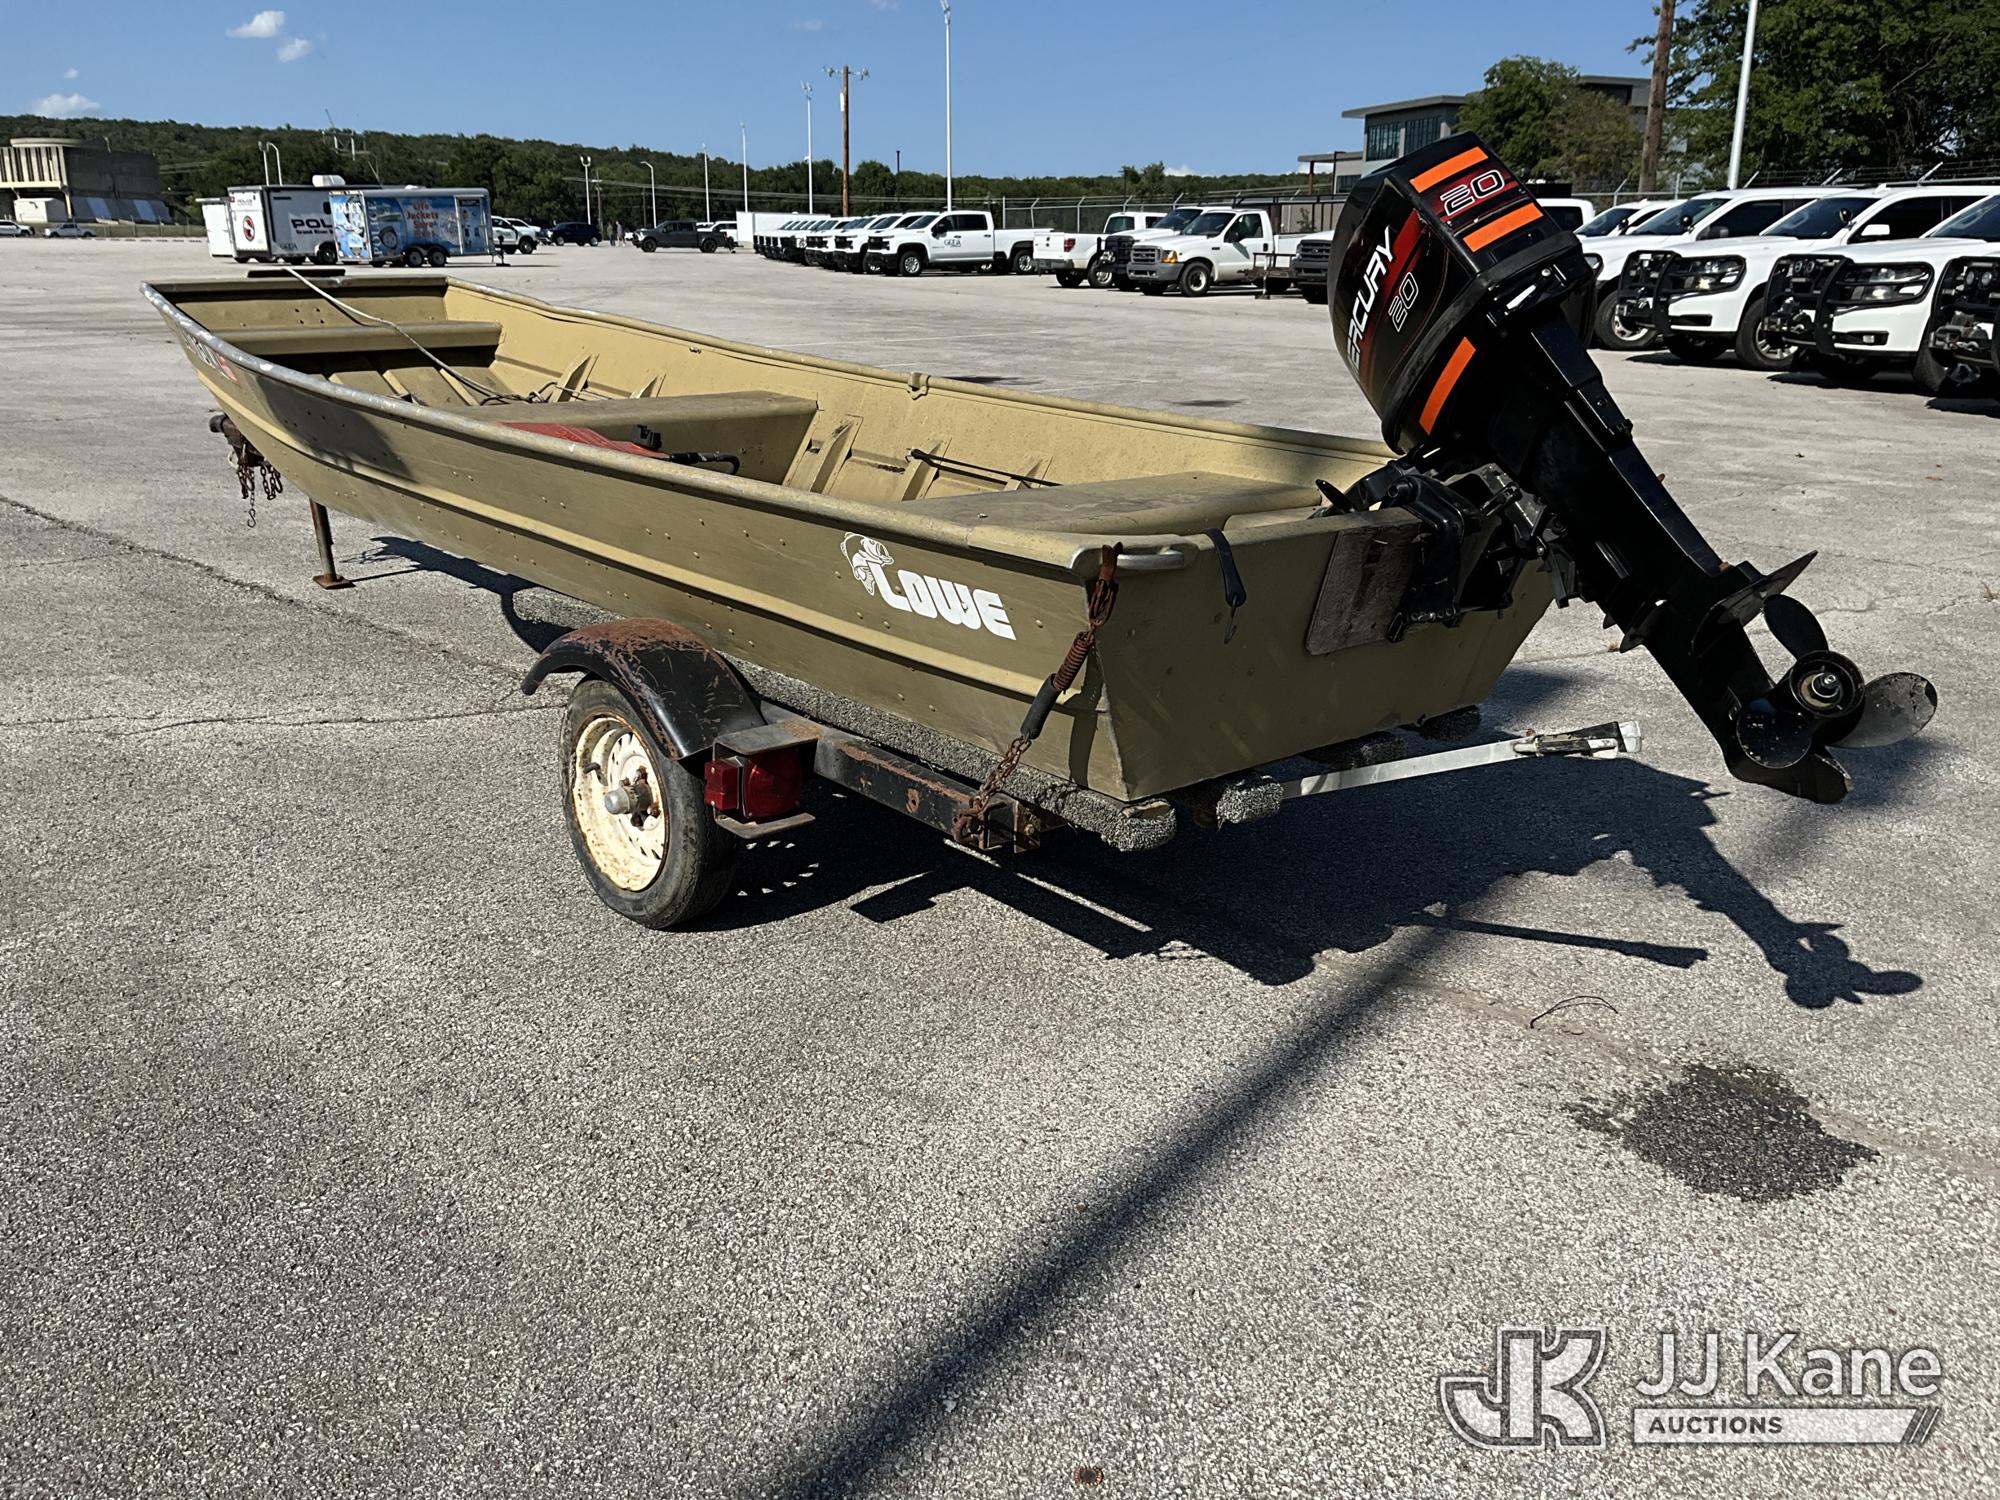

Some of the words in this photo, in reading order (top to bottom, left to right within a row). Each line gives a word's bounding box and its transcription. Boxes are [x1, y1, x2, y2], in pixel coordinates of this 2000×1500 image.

[1440, 169, 1505, 216] 20
[367, 200, 383, 256] POLICE
[1347, 225, 1393, 384] ERCURY
[1388, 271, 1419, 332] 20
